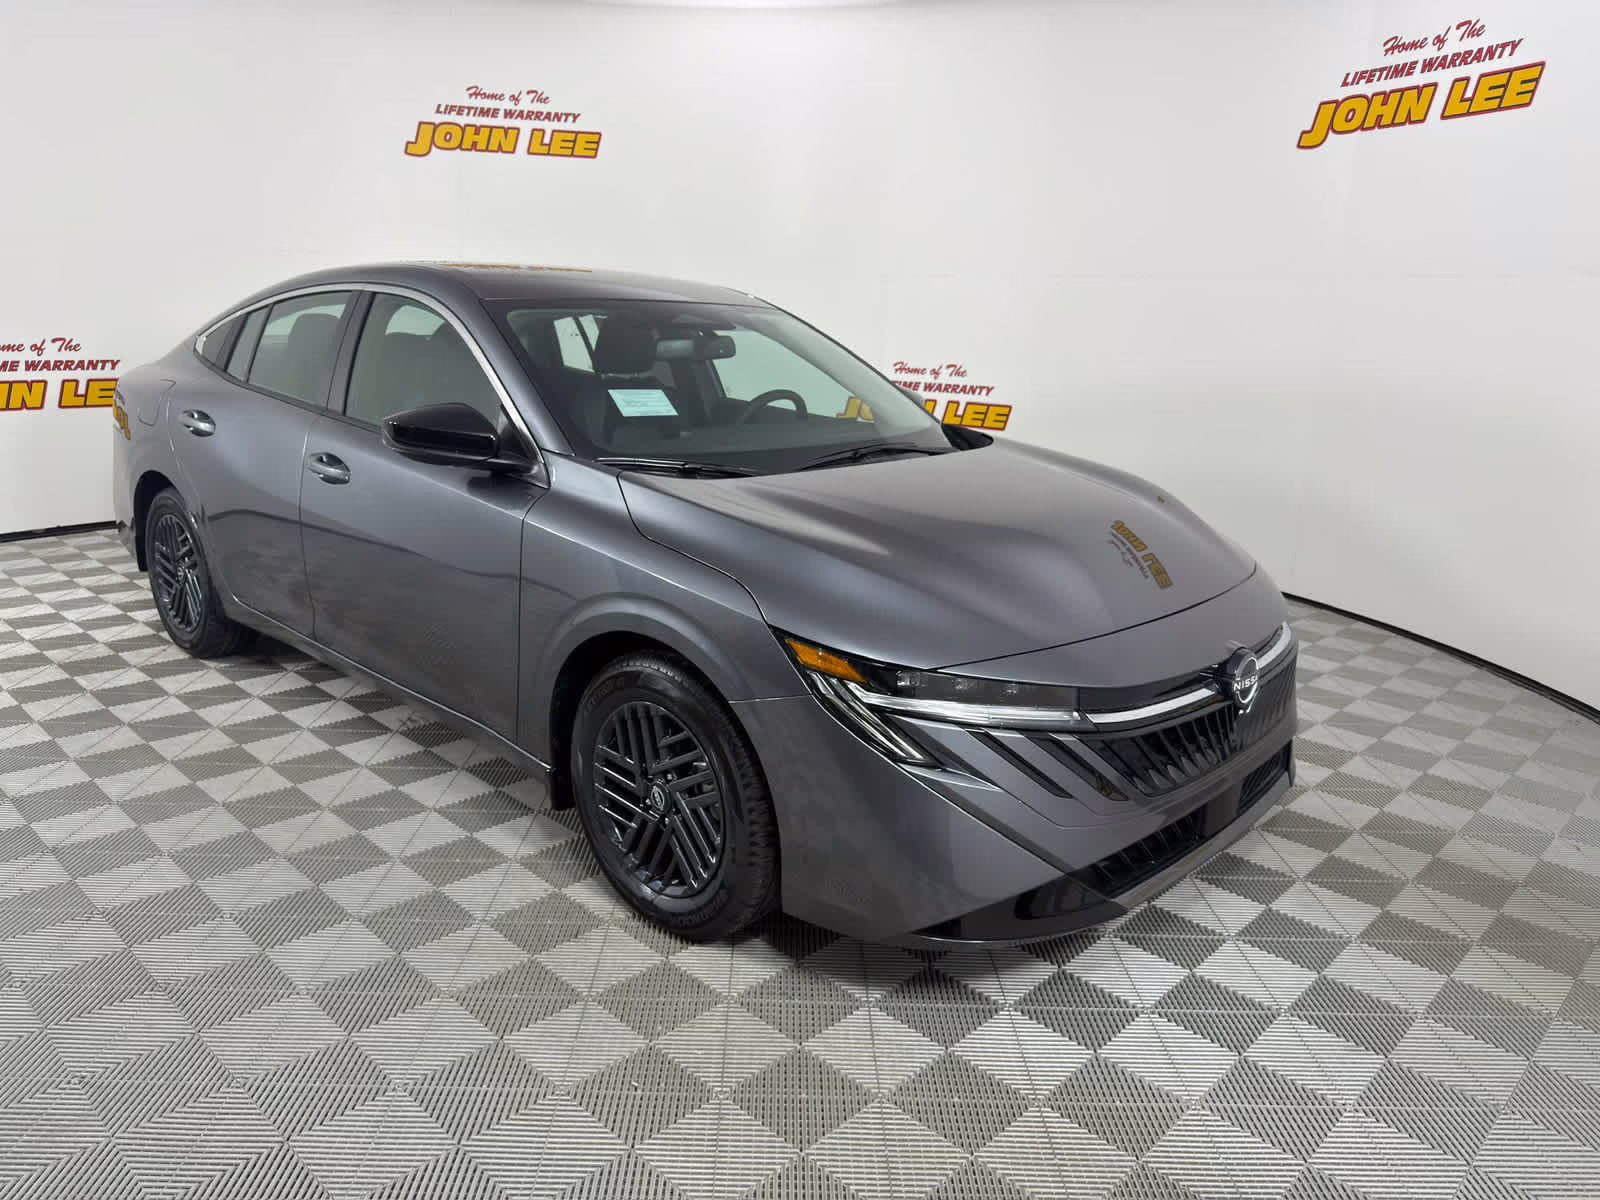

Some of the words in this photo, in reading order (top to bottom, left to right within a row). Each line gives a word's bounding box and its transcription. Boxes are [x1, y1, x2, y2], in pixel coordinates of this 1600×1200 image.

[1383, 36, 1428, 56] Home
[1432, 25, 1450, 49] of
[1456, 18, 1485, 42] The
[1341, 60, 1418, 87] LIFETIME
[1420, 38, 1523, 74] WARRANTY
[466, 86, 505, 101] Home
[509, 91, 521, 105] of
[526, 90, 550, 104] The
[1297, 82, 1438, 149] JOHN
[1440, 61, 1546, 120] LEE
[435, 104, 500, 119] LIFETIME
[504, 107, 581, 124] WARRANTY
[404, 121, 520, 157] JOHN
[527, 128, 602, 159] LEE
[30, 339, 46, 357] of
[51, 337, 81, 352] The
[25, 360, 120, 372] WARRANTY
[893, 361, 927, 376] Home
[929, 364, 942, 380] of
[946, 364, 968, 377] The
[58, 378, 119, 409] LE
[923, 382, 994, 396] WARRANTY
[942, 400, 1012, 431] LEE
